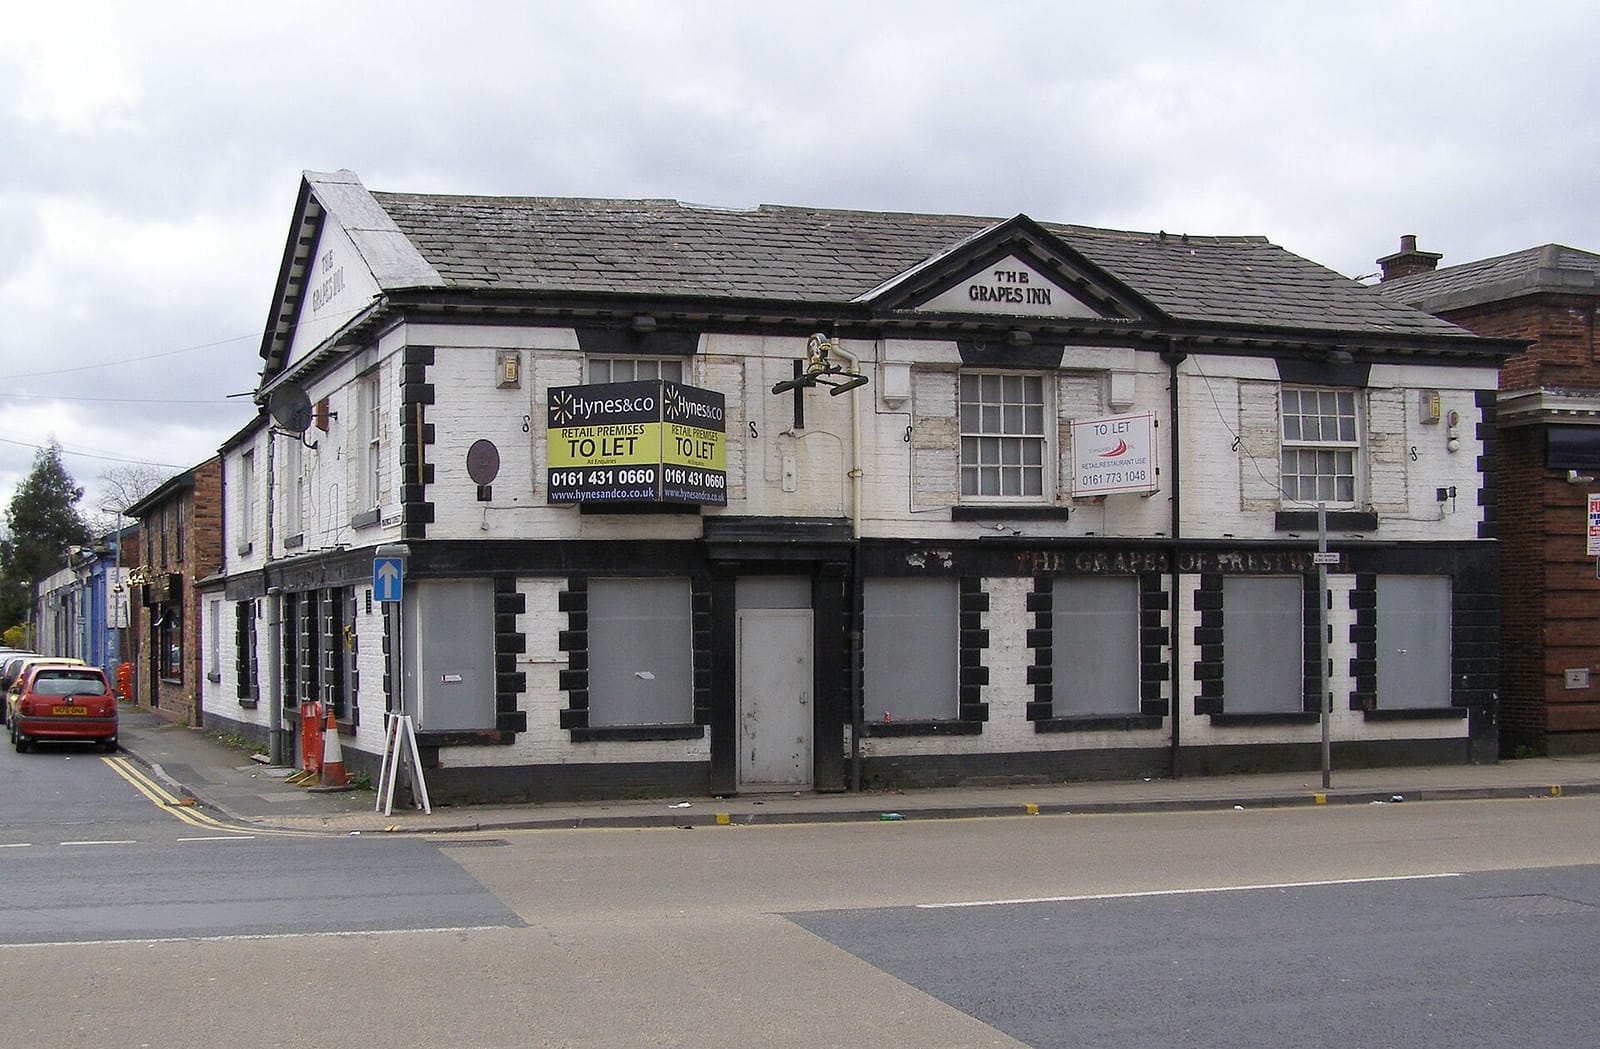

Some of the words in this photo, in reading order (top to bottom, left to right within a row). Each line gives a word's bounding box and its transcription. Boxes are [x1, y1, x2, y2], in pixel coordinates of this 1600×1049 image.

[994, 271, 1029, 283] THE
[969, 285, 1023, 303] GRAPES
[1026, 288, 1051, 305] INN
[562, 428, 594, 438] RETAIL
[597, 425, 645, 436] PREMISES
[672, 425, 691, 437] RETAIL
[693, 429, 718, 441] PREMISES
[1094, 424, 1107, 435] TO
[1112, 421, 1131, 433] LET
[568, 439, 596, 457] TO
[602, 437, 638, 456] LET
[676, 437, 692, 456] TO
[696, 440, 715, 460] LET
[552, 471, 583, 486] 0161
[588, 470, 613, 485] 431
[619, 469, 654, 484] 0660
[665, 469, 686, 484] 0161
[688, 471, 703, 486] 431
[705, 474, 724, 488] 0660
[1082, 474, 1103, 485] 0161
[1106, 472, 1121, 483] 773
[1125, 470, 1146, 481] 1048
[551, 487, 654, 501] www.hynesandco.co.uk
[1016, 551, 1064, 572] THE
[1075, 551, 1168, 573] GRAPES
